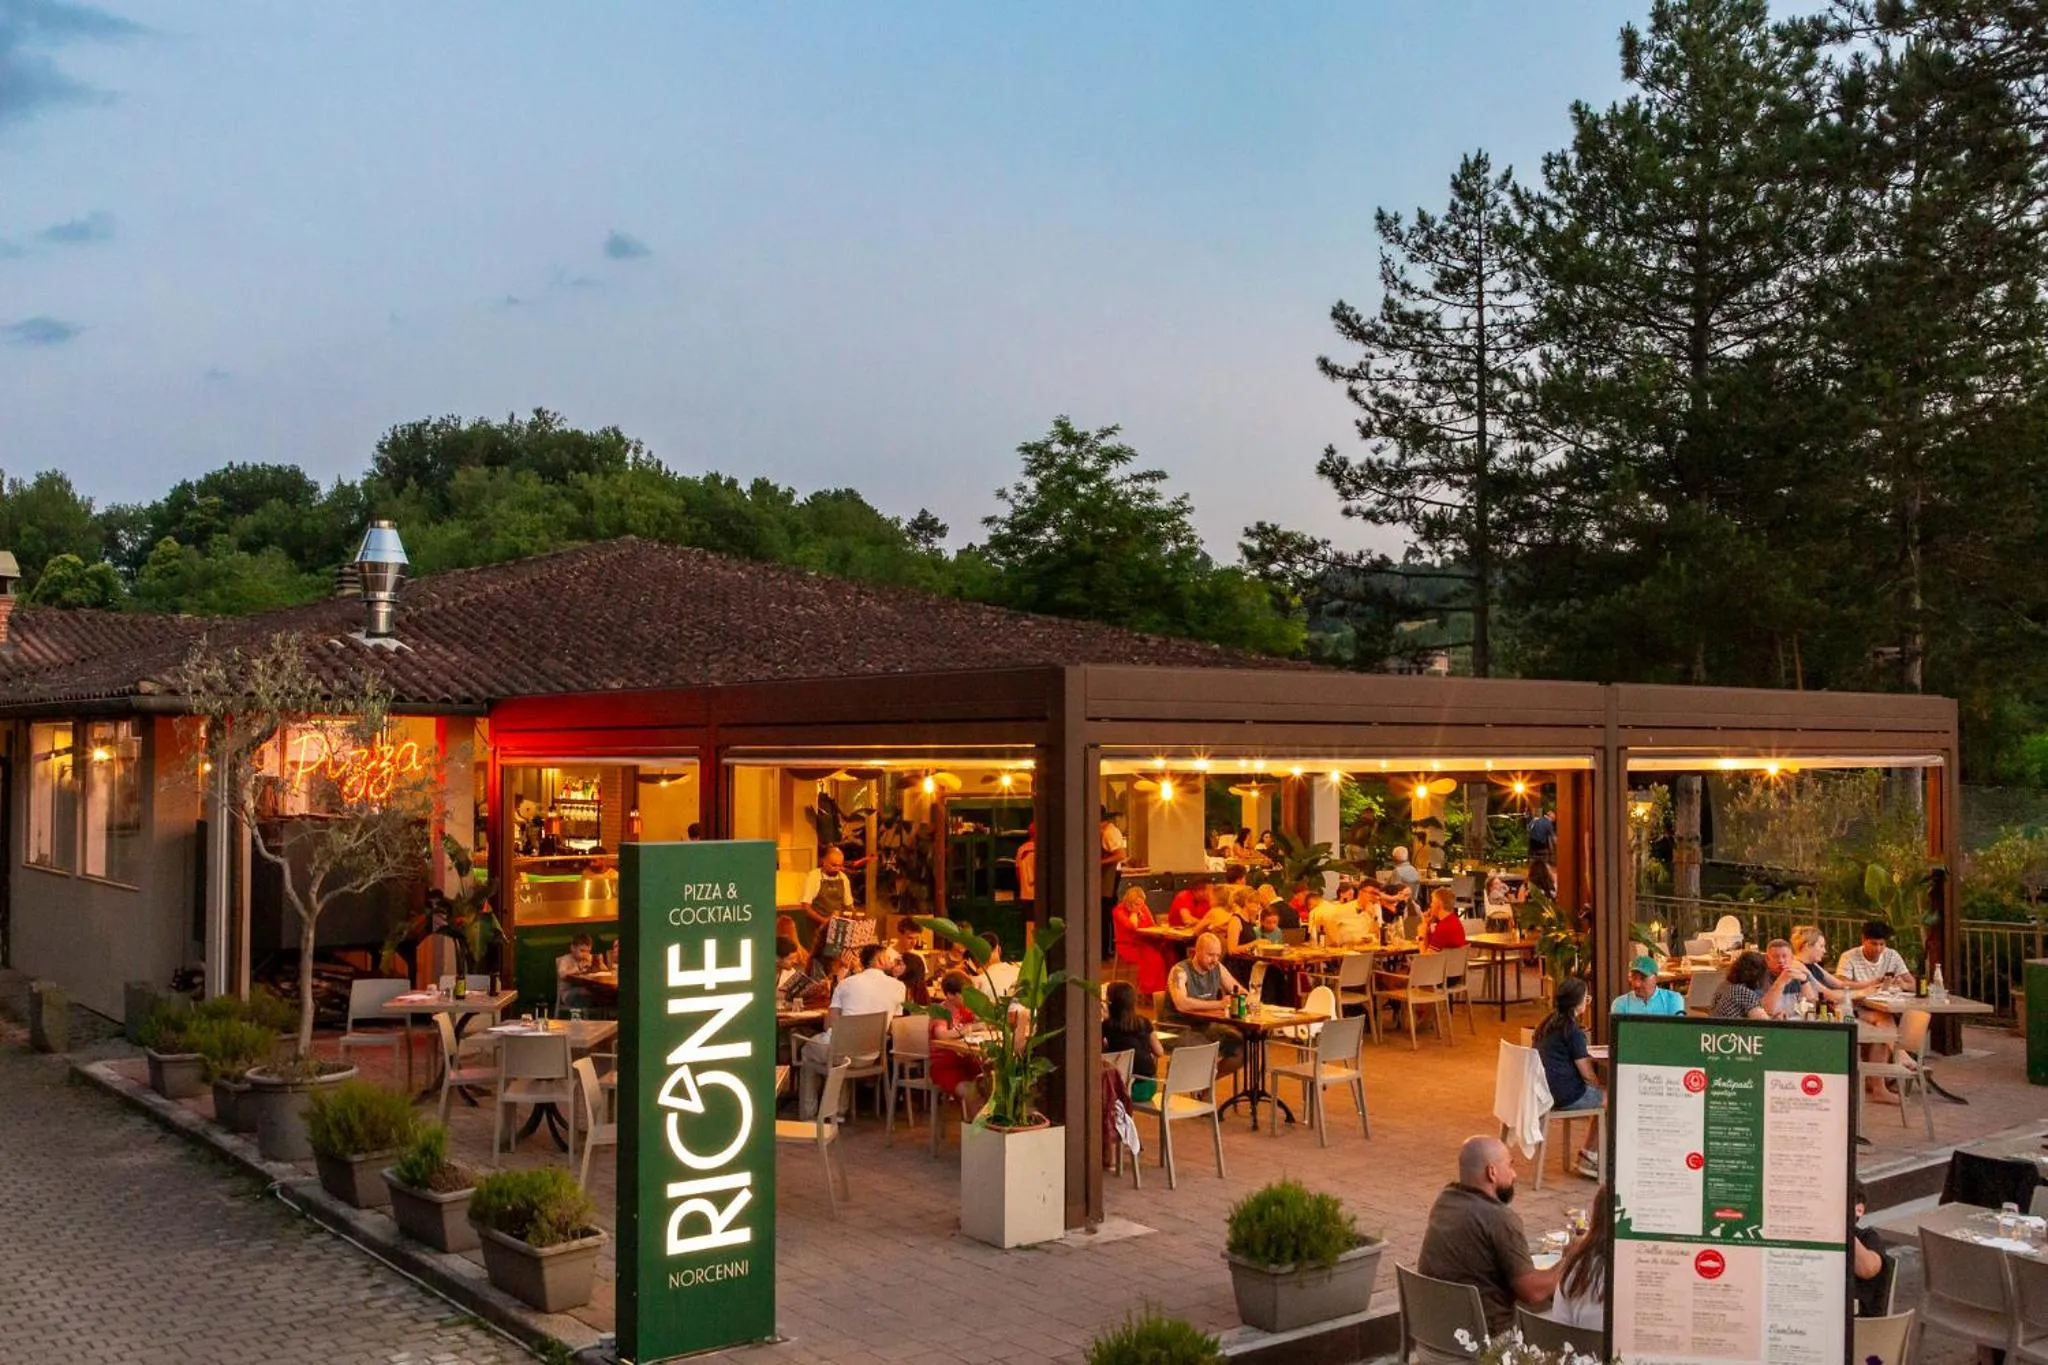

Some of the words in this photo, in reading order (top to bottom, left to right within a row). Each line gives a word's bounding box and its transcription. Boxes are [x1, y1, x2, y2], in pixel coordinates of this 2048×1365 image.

[292, 730, 423, 802] Pizza
[683, 882, 722, 901] PIZZA
[726, 882, 738, 899] &
[668, 904, 752, 926] COCKTAILS
[1700, 1033, 1765, 1055] RIONE
[657, 938, 753, 1256] RIONE
[668, 1259, 749, 1289] NORCENNI
